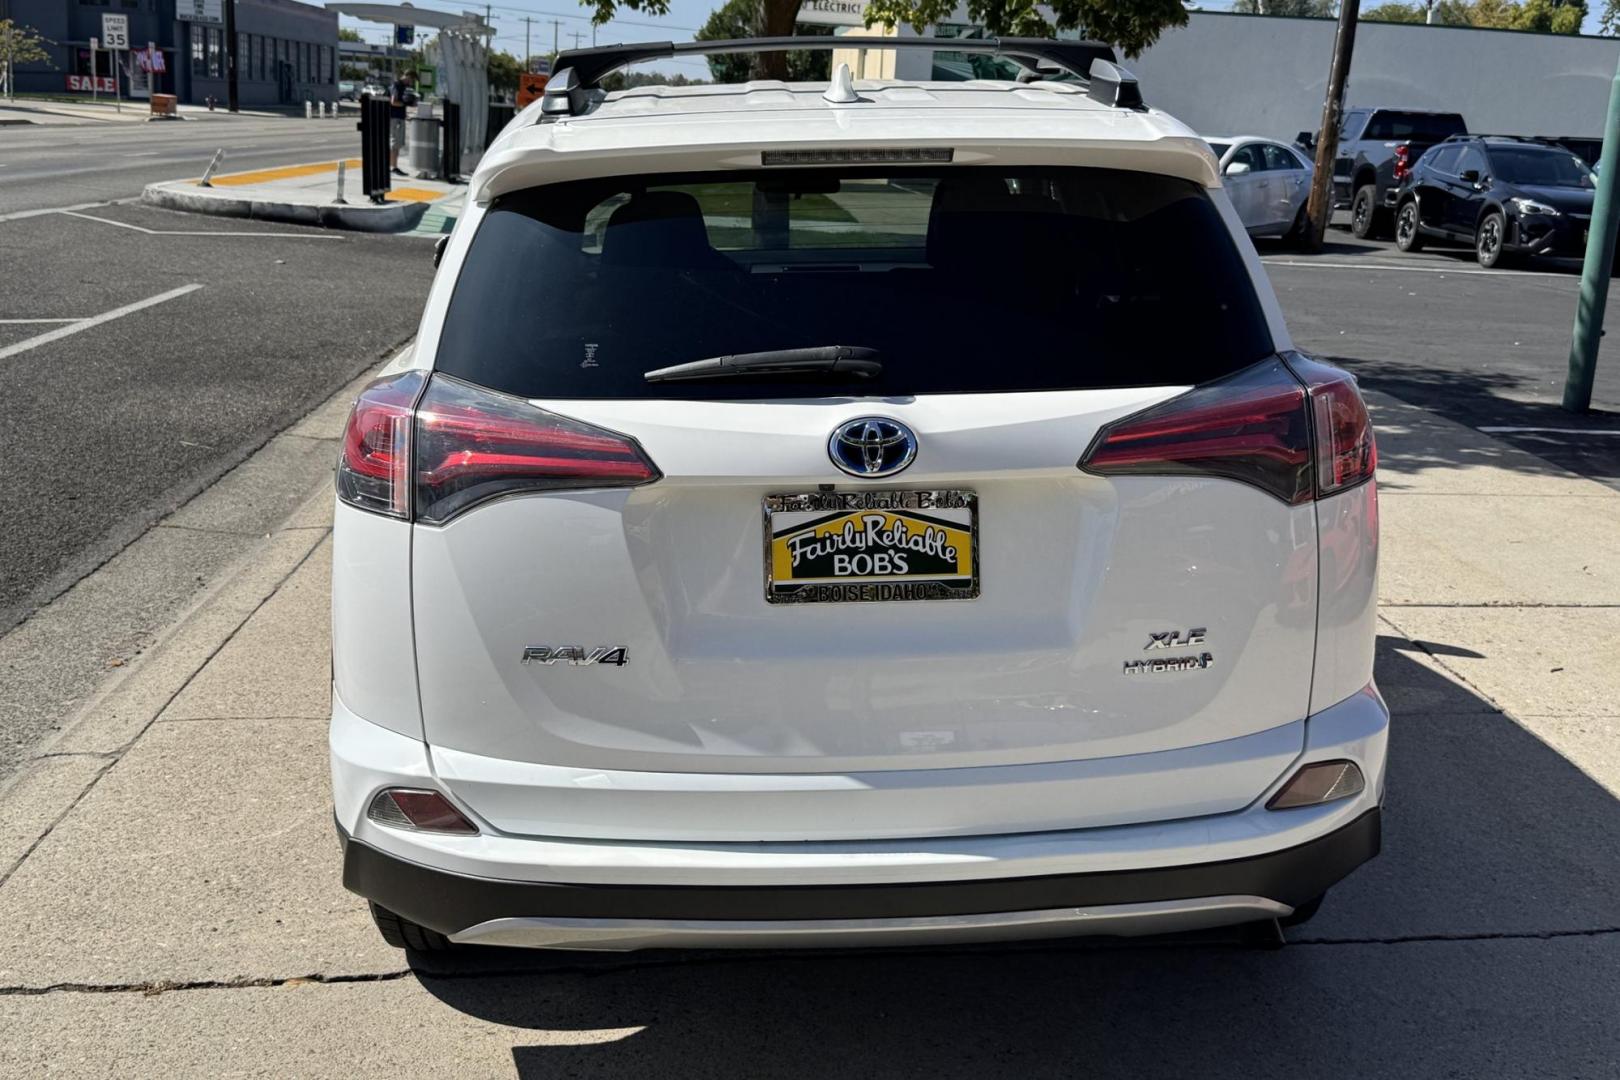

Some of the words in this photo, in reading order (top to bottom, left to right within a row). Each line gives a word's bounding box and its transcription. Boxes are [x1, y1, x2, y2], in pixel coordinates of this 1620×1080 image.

[106, 33, 126, 46] 35
[69, 76, 115, 92] SALE
[787, 519, 866, 567] Fairly
[862, 514, 956, 563] Reliable
[833, 549, 909, 576] BOB'S
[819, 584, 870, 601] BOISE
[876, 583, 927, 600] IDAHO
[1143, 627, 1207, 650] XLE
[521, 645, 629, 667] RAV4
[1123, 656, 1199, 675] HYBRID
